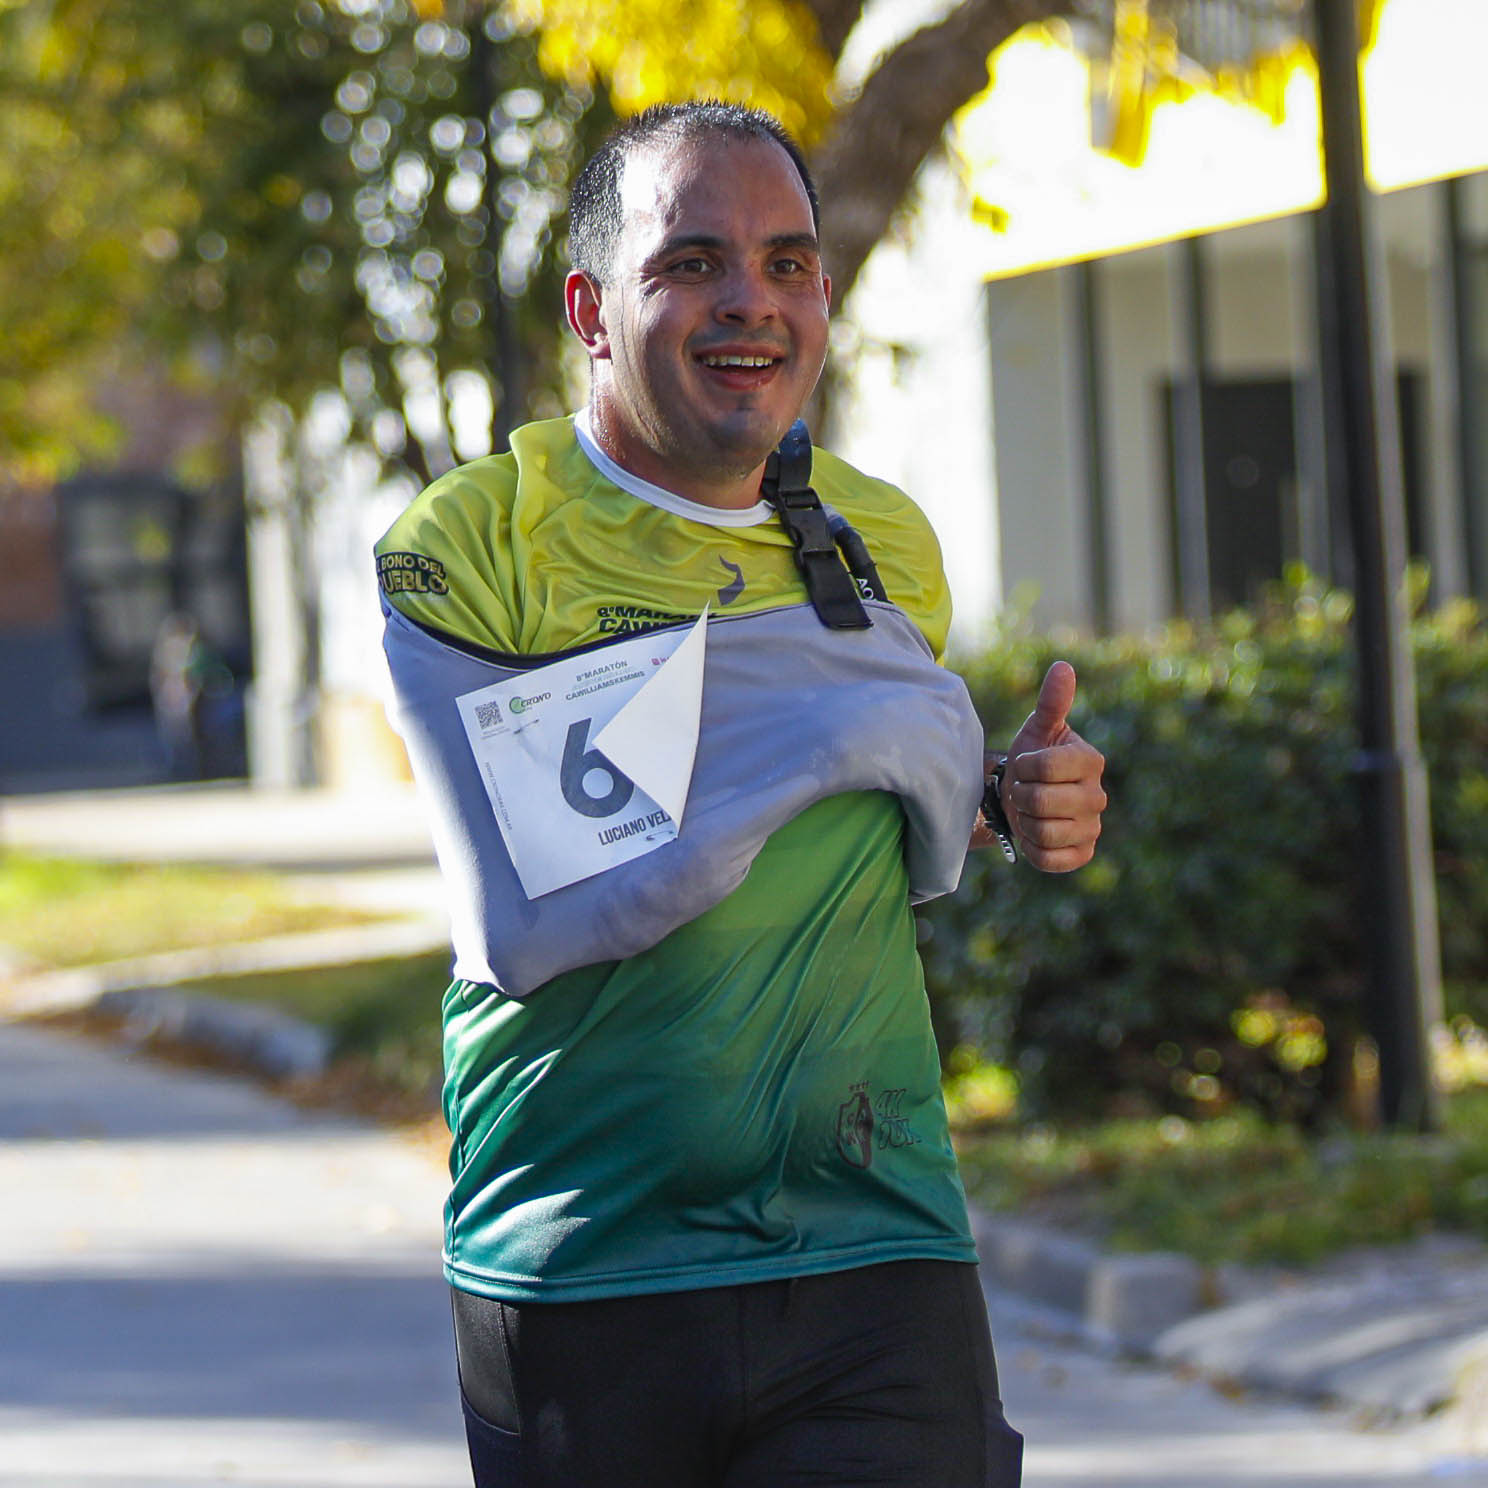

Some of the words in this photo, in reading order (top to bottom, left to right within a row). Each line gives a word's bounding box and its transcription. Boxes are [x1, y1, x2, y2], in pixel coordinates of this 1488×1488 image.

[381, 554, 415, 570] BONO
[418, 556, 446, 579] DEL
[378, 569, 449, 594] UEBLO
[598, 817, 647, 846] LUCIANO
